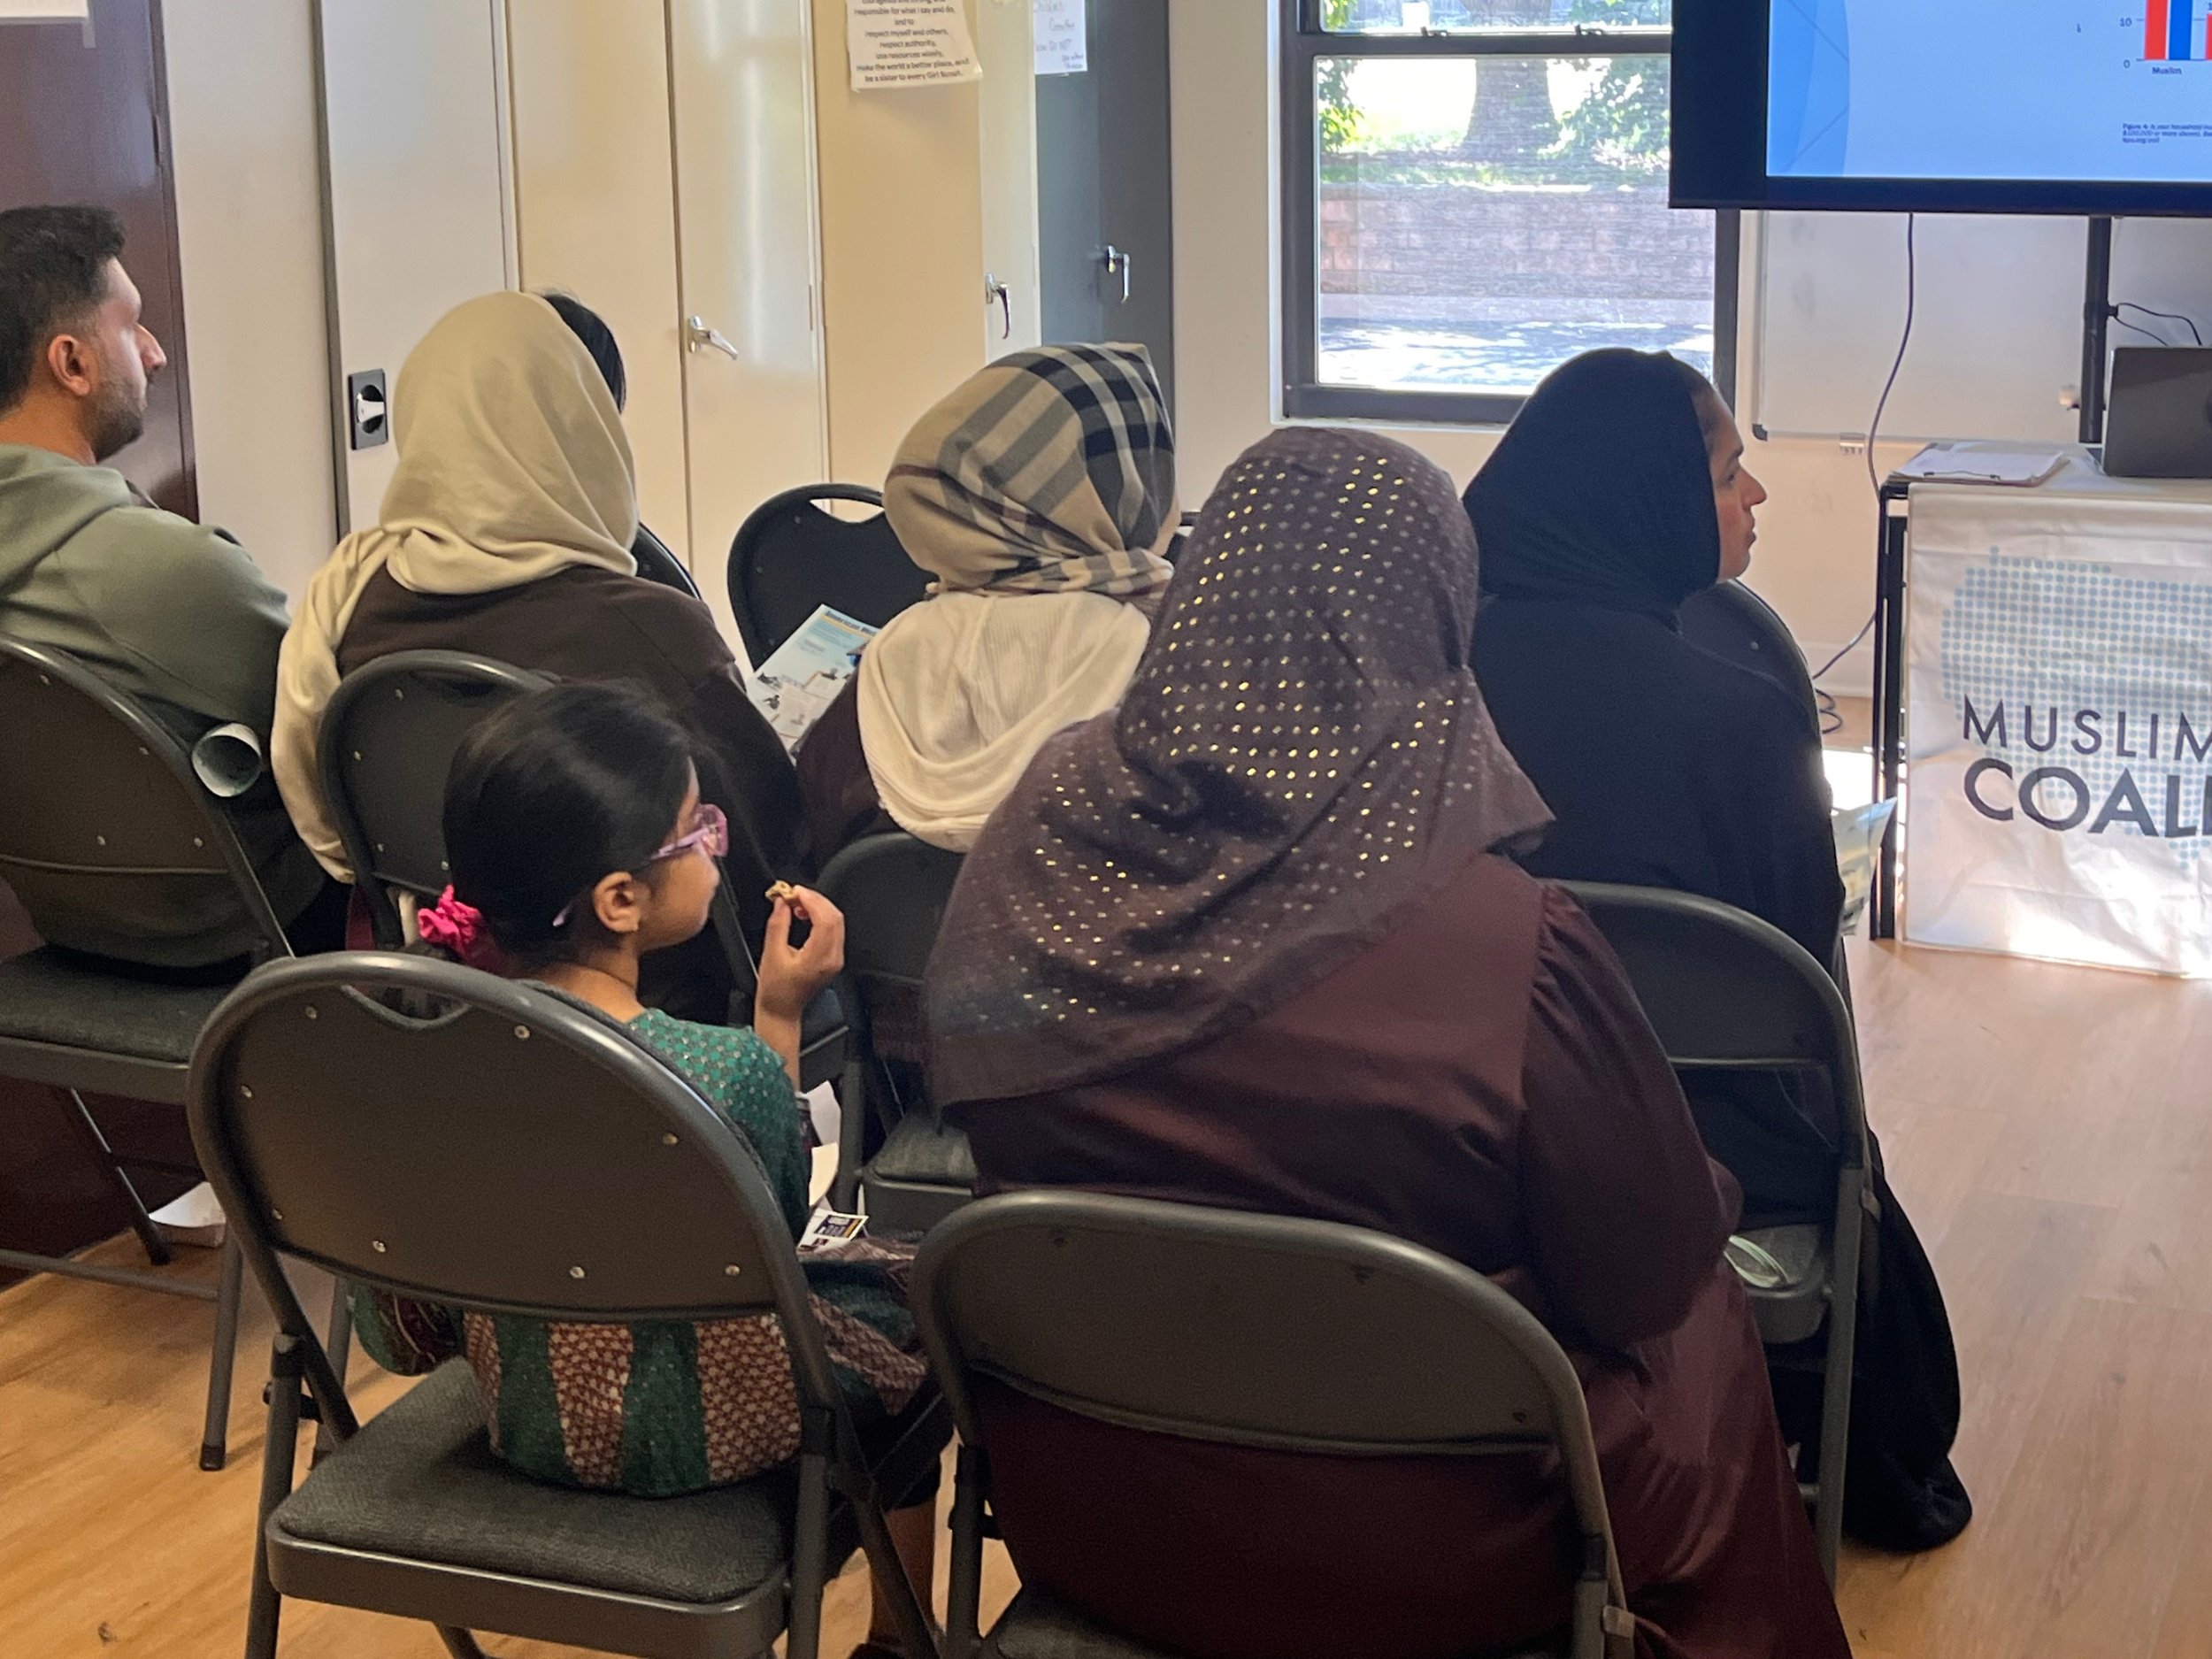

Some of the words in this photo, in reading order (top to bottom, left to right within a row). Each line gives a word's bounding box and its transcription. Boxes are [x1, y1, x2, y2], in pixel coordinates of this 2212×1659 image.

[2119, 18, 2132, 27] 10
[926, 27, 949, 36] others,
[904, 39, 937, 48] authority,
[933, 59, 954, 68] place,
[2124, 59, 2131, 68] 0
[2152, 66, 2182, 75] Muslim
[1962, 694, 2212, 763] MUSLIM
